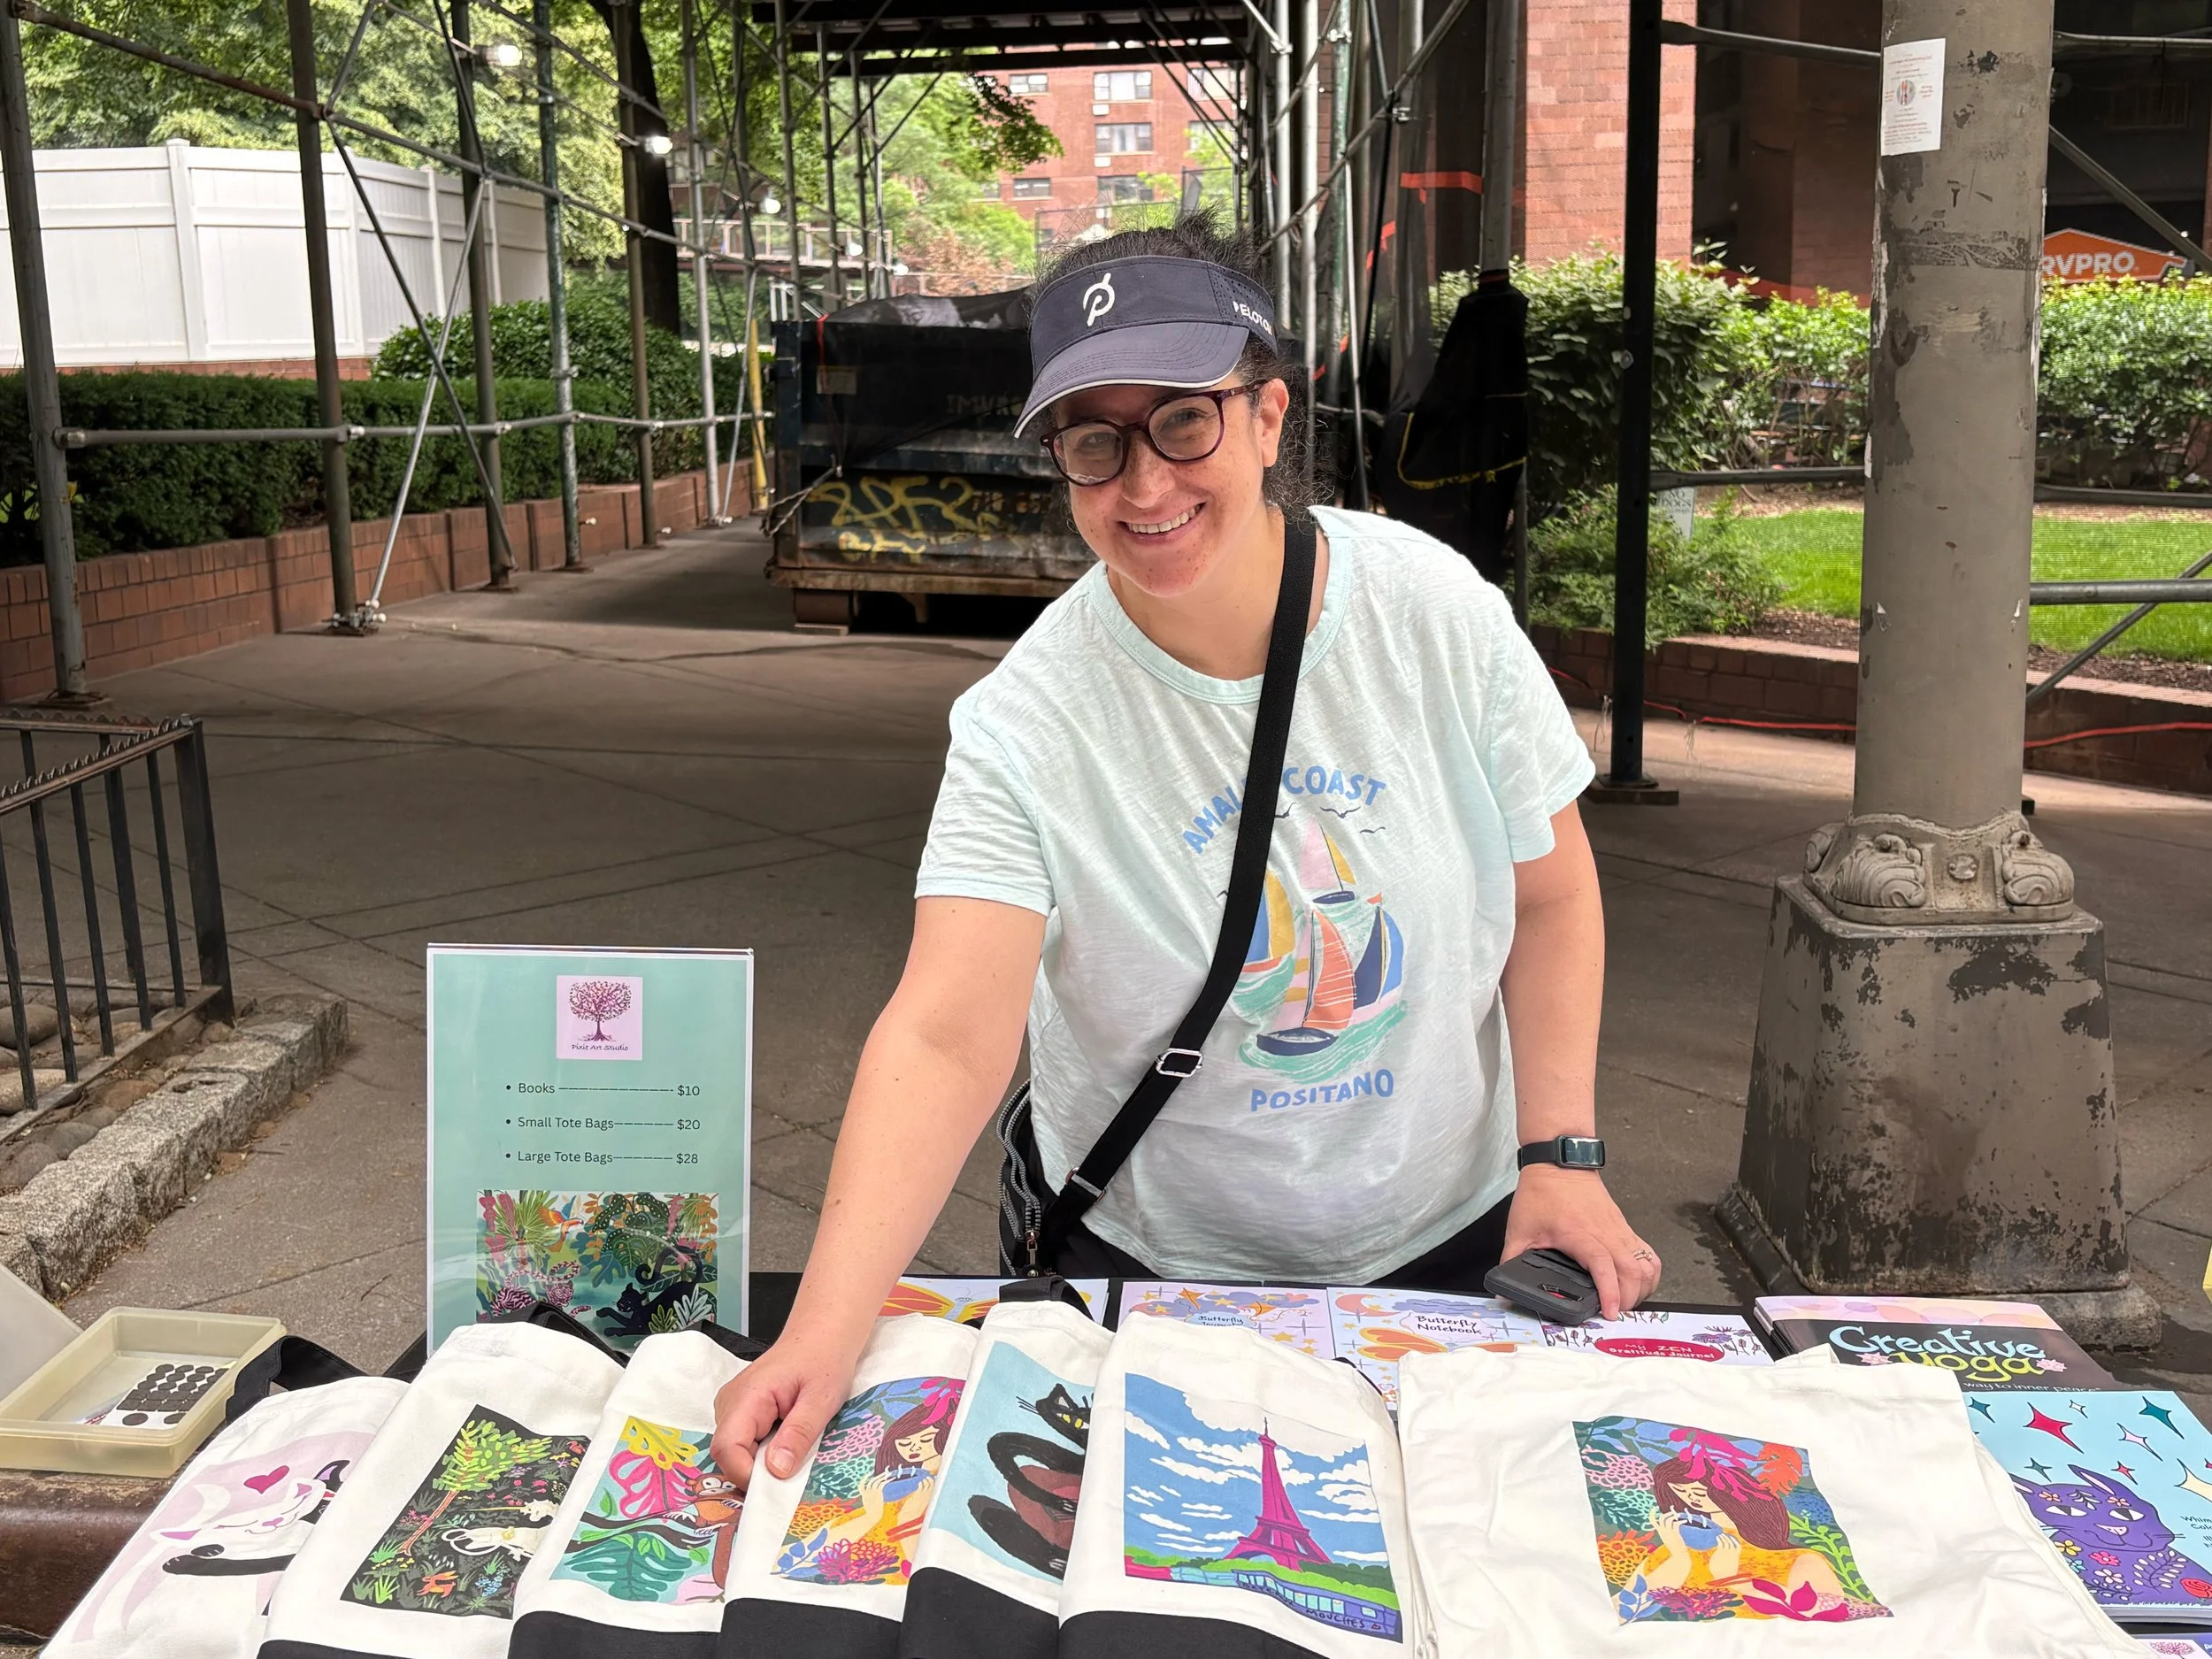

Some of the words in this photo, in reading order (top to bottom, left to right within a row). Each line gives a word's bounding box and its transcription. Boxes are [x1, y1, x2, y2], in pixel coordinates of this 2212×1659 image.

[1182, 779, 1246, 855] AMAL
[1283, 765, 1387, 807] COAST
[518, 1082, 556, 1094] Books
[677, 1084, 701, 1097] $10
[1250, 1068, 1394, 1112] POSITANO
[518, 1117, 552, 1128] Small
[555, 1117, 582, 1128] Tote
[585, 1118, 614, 1131] Bags
[677, 1118, 701, 1131] $20
[518, 1150, 551, 1164] Large
[554, 1151, 581, 1163] Tote
[584, 1152, 613, 1165] Bags
[676, 1152, 699, 1164] $28
[1198, 1315, 1244, 1326] Butterfly
[1416, 1315, 1478, 1328] Butterfly
[1417, 1323, 1482, 1335] Notebook
[1828, 1325, 2047, 1359] Creative
[1669, 1350, 1716, 1359] Journal
[1962, 1381, 1993, 1390] way
[1306, 1609, 1365, 1629] MOUCHES
